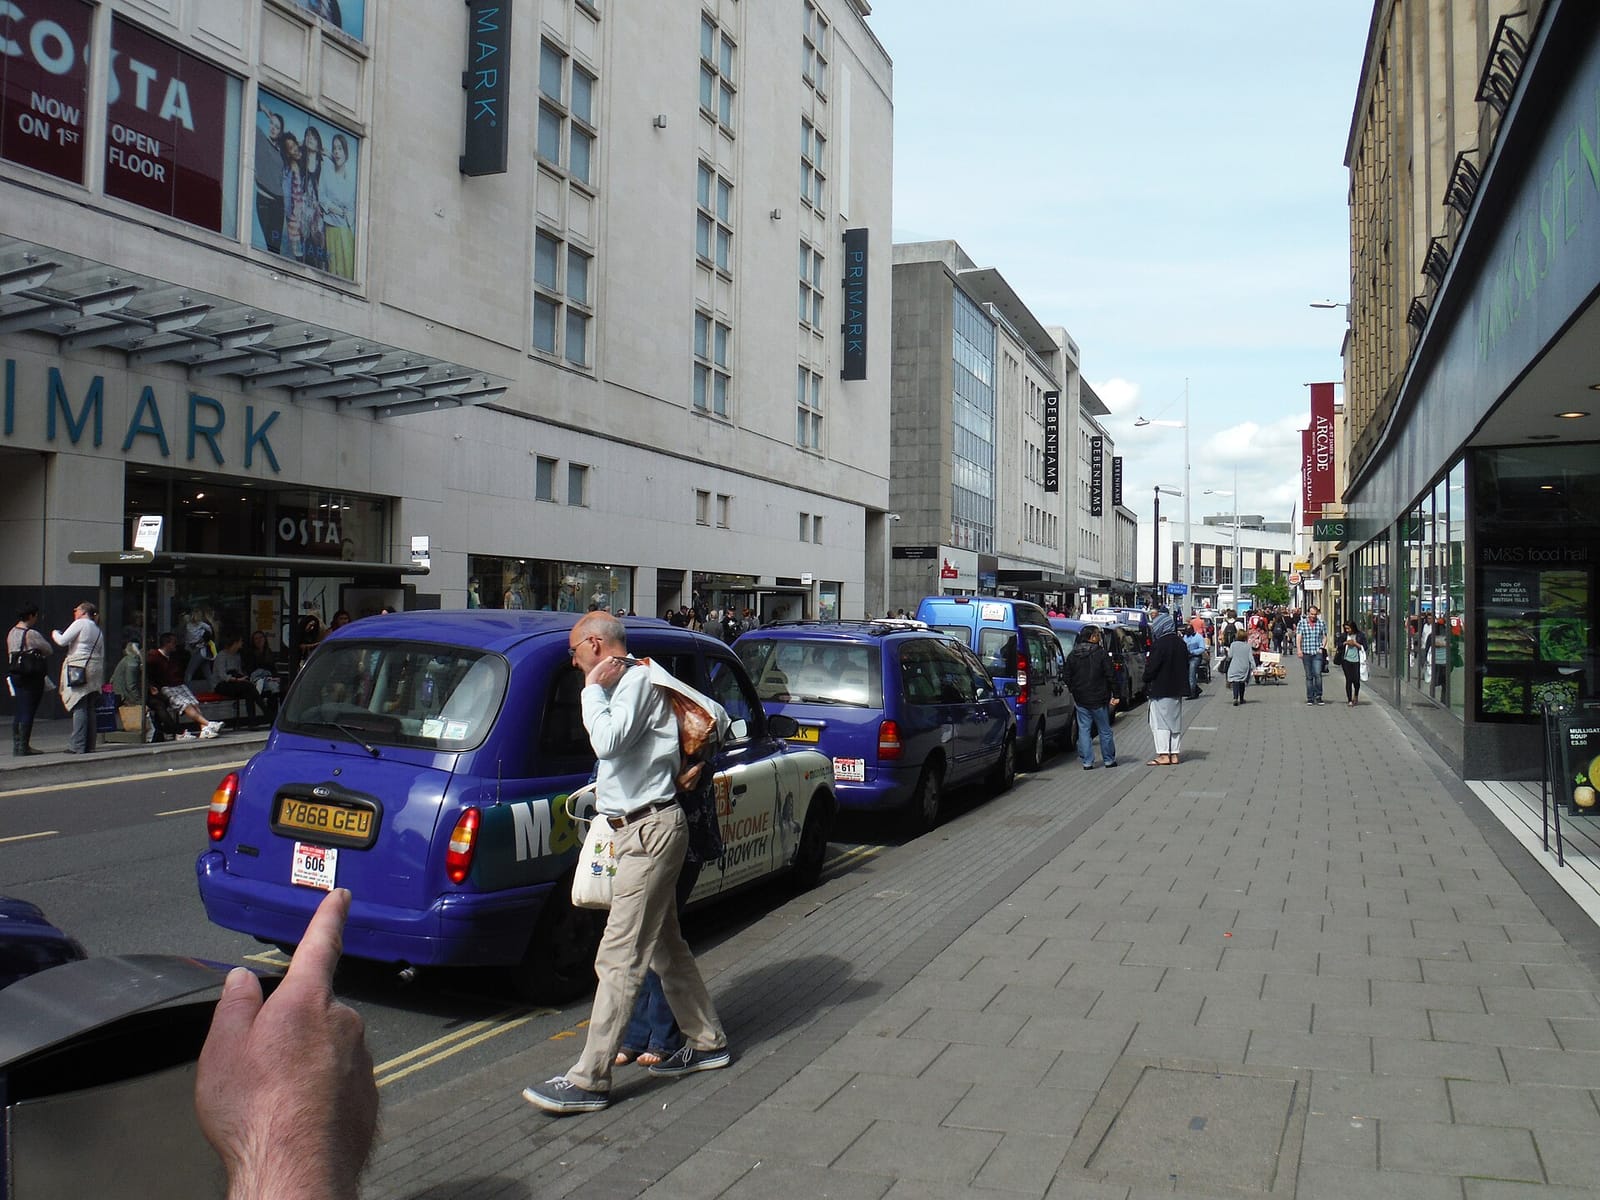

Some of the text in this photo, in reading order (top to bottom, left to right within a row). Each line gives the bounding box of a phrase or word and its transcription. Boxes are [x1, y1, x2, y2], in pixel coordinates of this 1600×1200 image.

[31, 91, 160, 158] NOW OPEN
[18, 113, 165, 184] ON 1ST FLOOR
[849, 251, 864, 351] PRIMARK
[1047, 397, 1056, 487] DEBENHAMS
[1316, 415, 1328, 472] ARCADE
[1093, 440, 1101, 512] DEBENHAMS
[262, 517, 340, 546] OSTA
[1316, 524, 1344, 536] M&S
[1488, 547, 1524, 561] M&S
[1528, 546, 1560, 561] food
[1564, 546, 1588, 561] hall
[841, 764, 856, 772] 611
[287, 802, 370, 832] Y868 GEU
[721, 812, 769, 843] INCOME
[305, 855, 325, 873] 606
[717, 835, 768, 871] GROWTH
